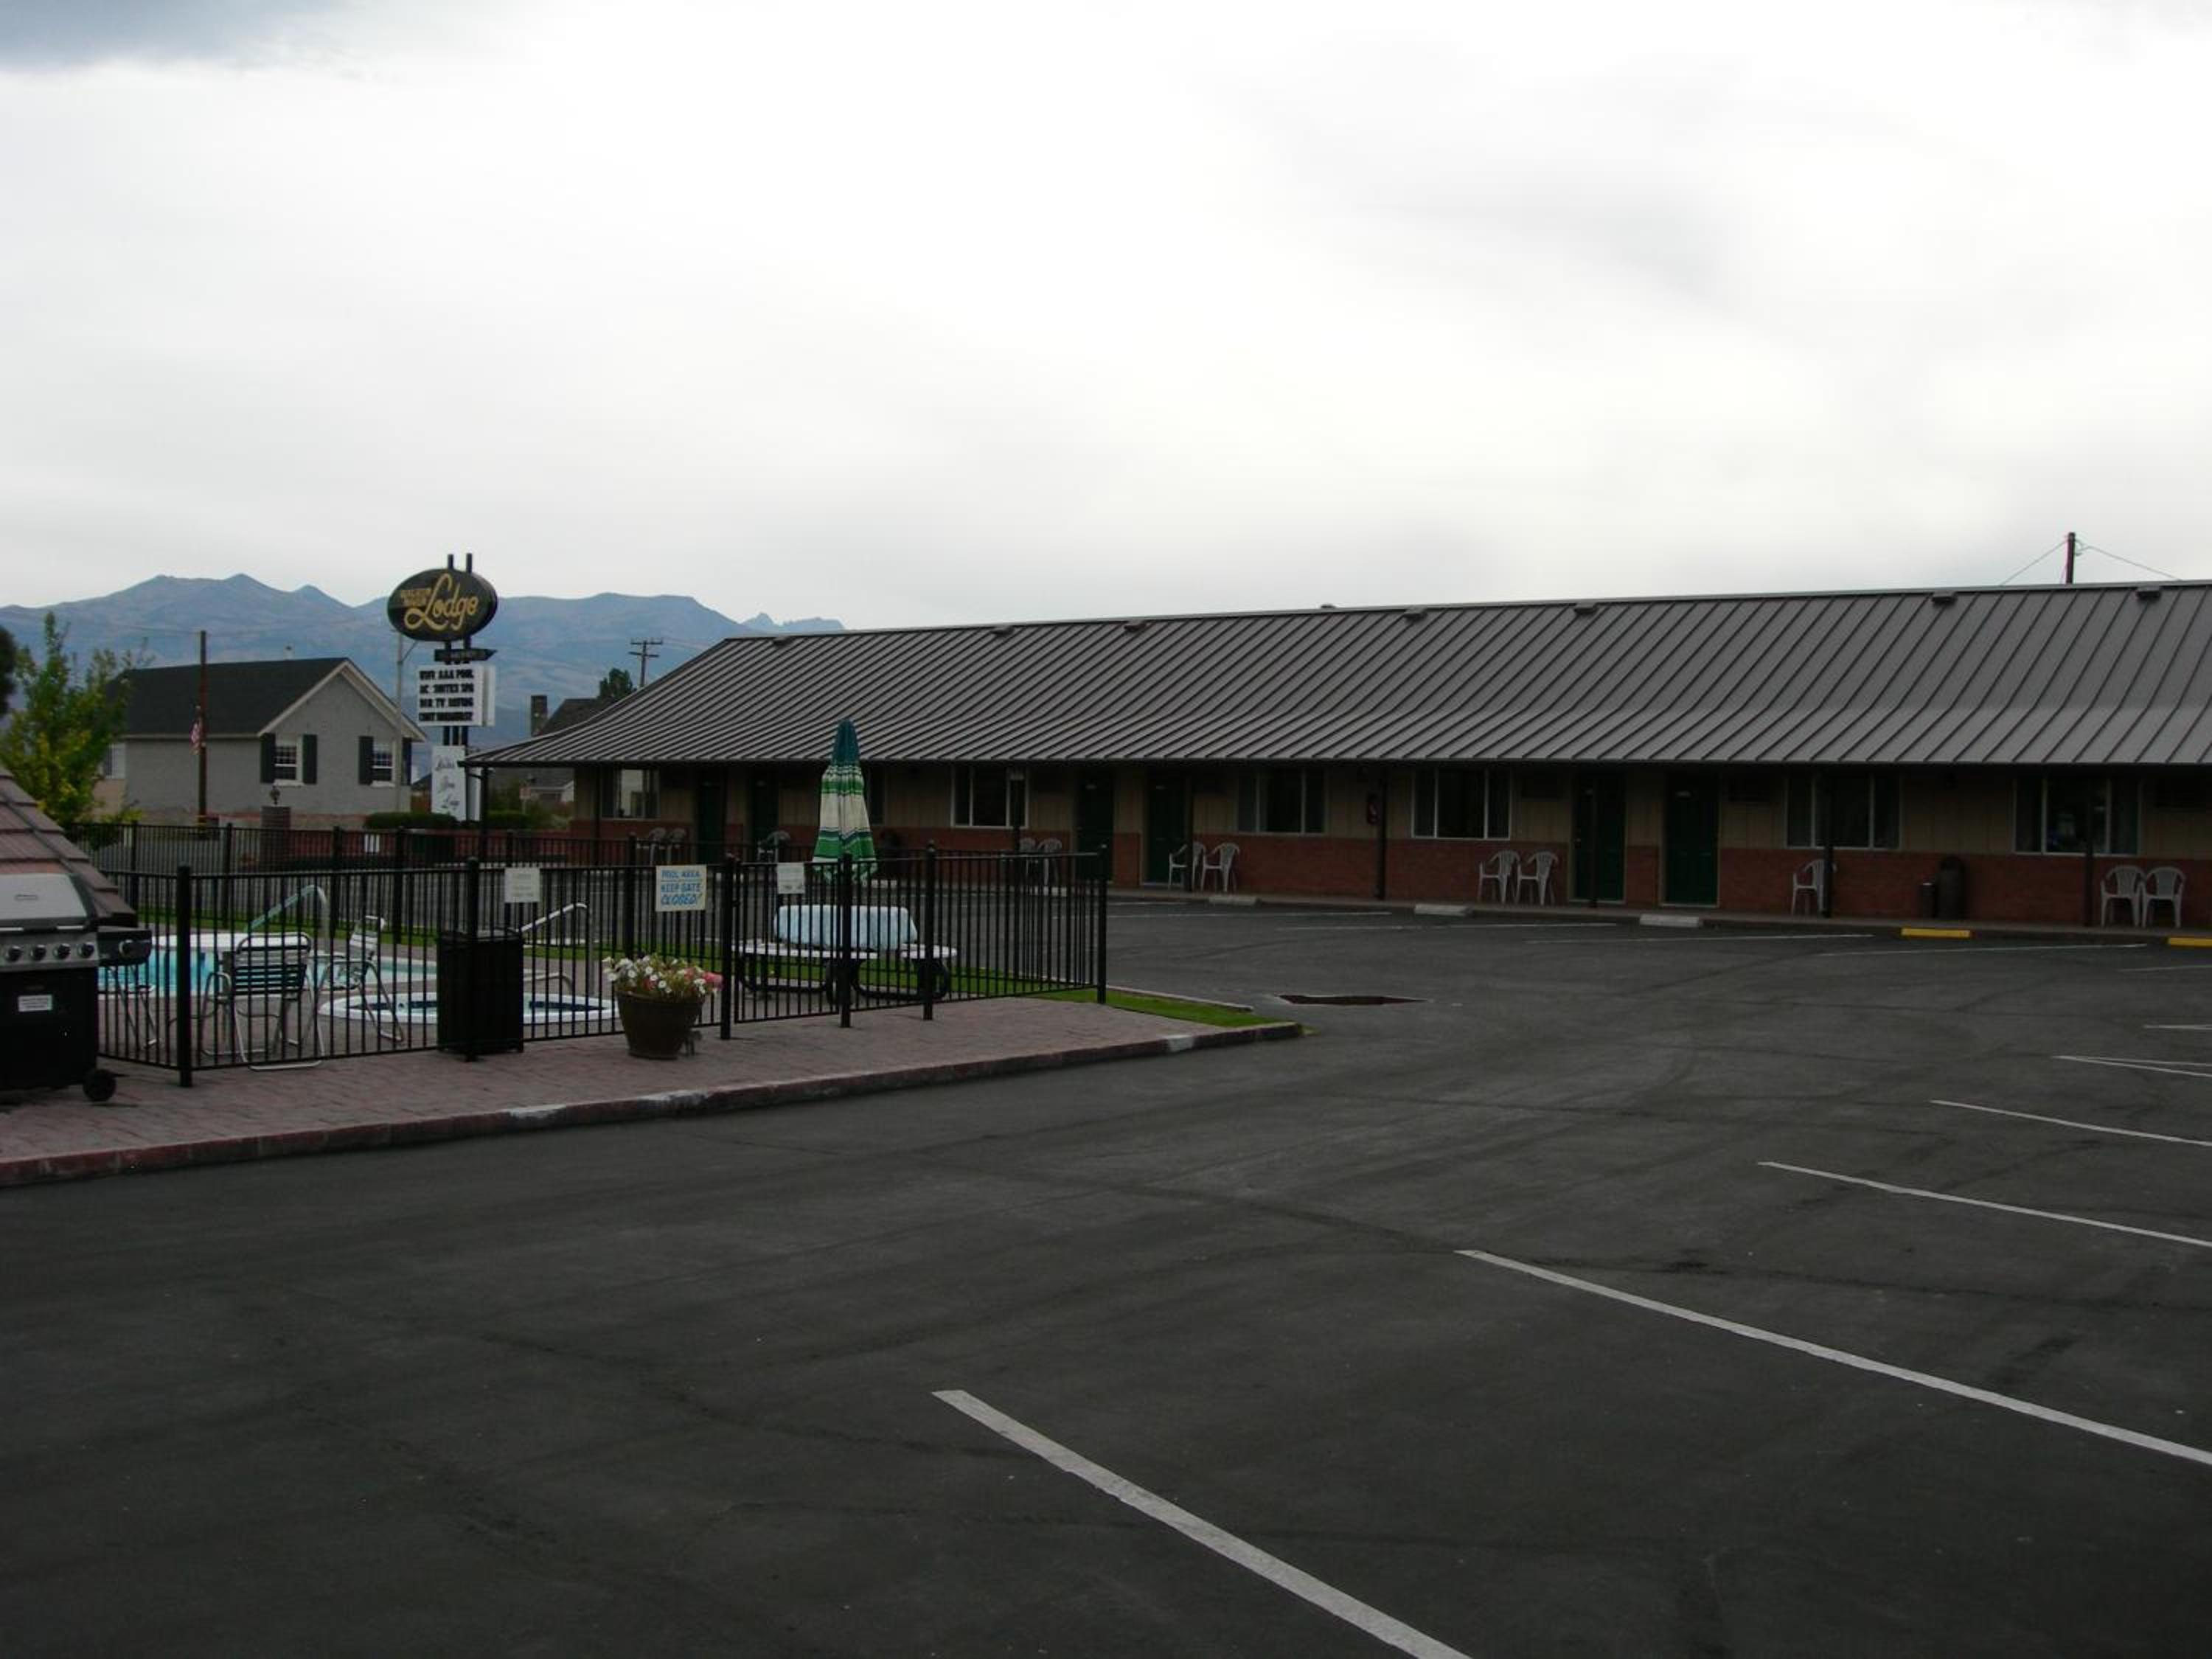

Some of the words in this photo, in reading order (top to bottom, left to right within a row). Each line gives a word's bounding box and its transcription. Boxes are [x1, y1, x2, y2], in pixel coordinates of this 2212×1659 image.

[404, 573, 479, 631] Lodge
[661, 883, 679, 892] KEEP
[681, 883, 700, 892] GATE
